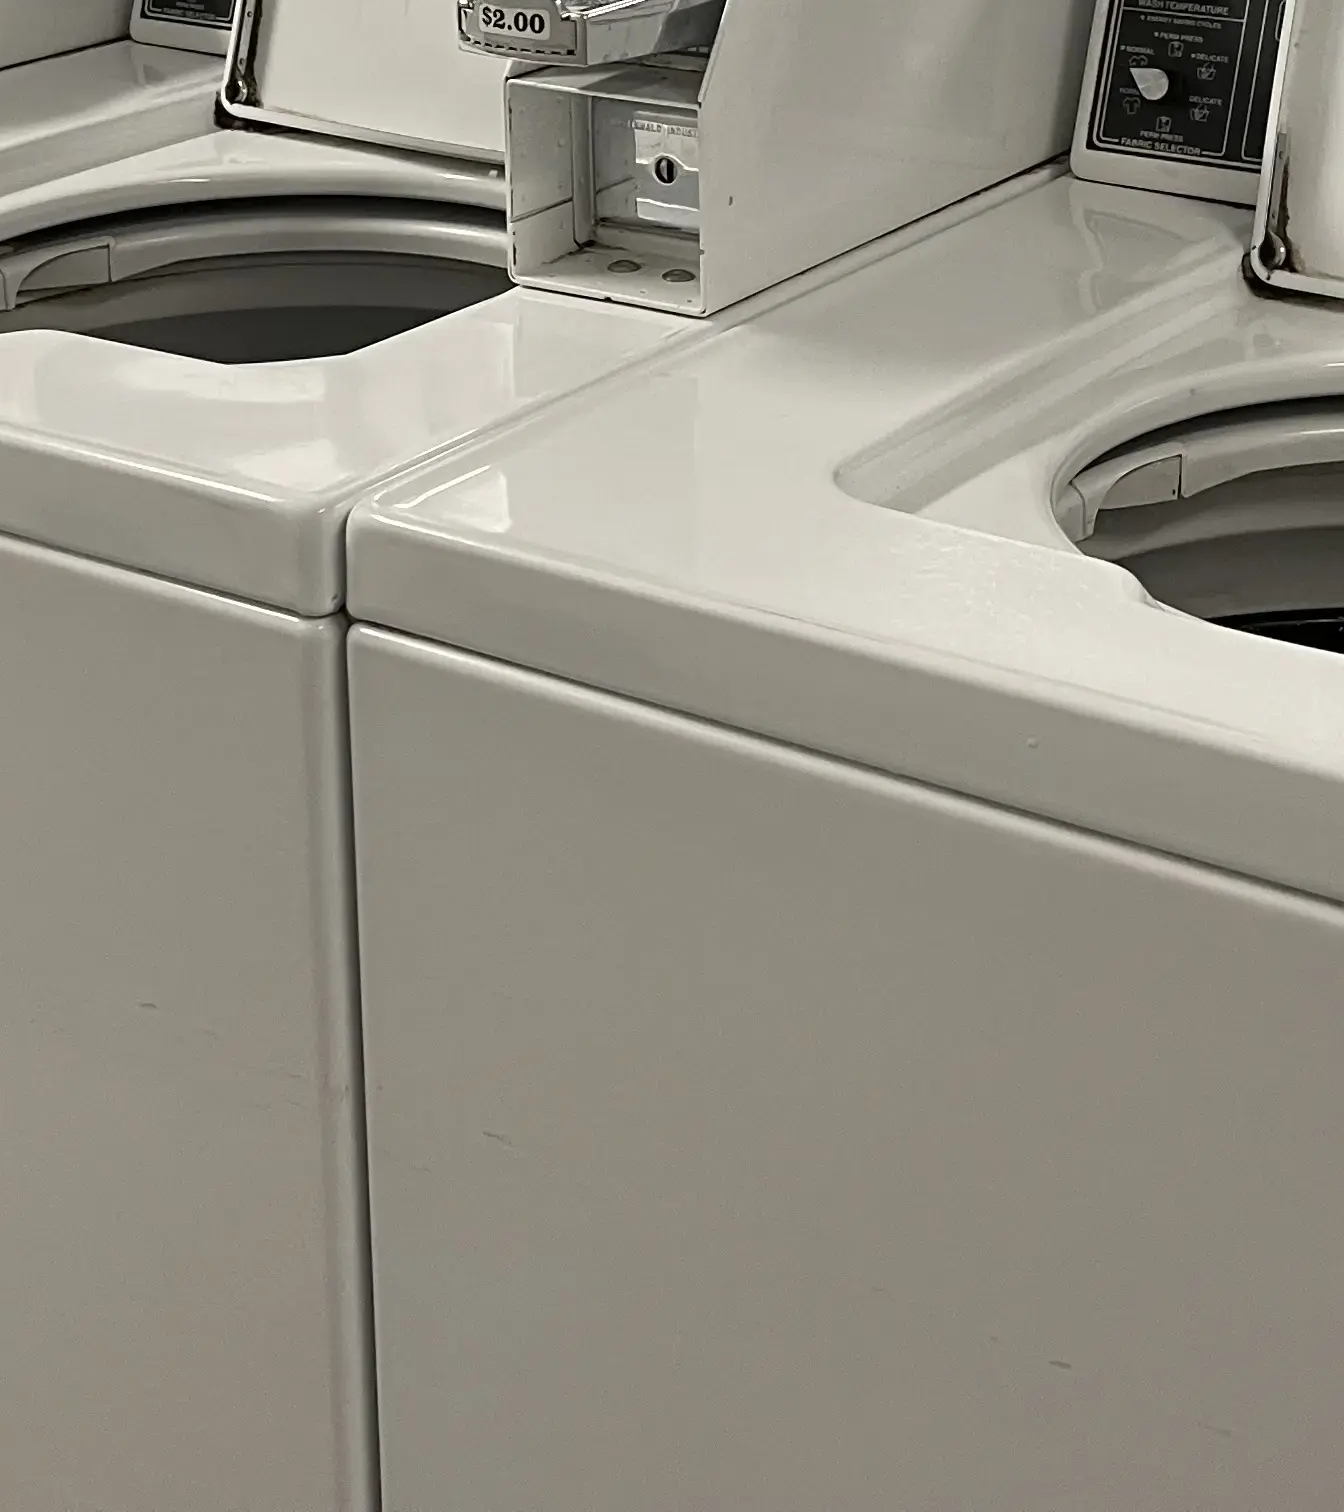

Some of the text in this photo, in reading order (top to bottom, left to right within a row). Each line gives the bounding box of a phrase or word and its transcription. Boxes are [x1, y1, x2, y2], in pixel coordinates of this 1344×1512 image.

[1167, 2, 1229, 16] TEMPERATURE
[482, 7, 545, 34] $2.00
[1189, 96, 1223, 106] DELICATE
[1121, 137, 1201, 155] FABRIC SELECTOR
